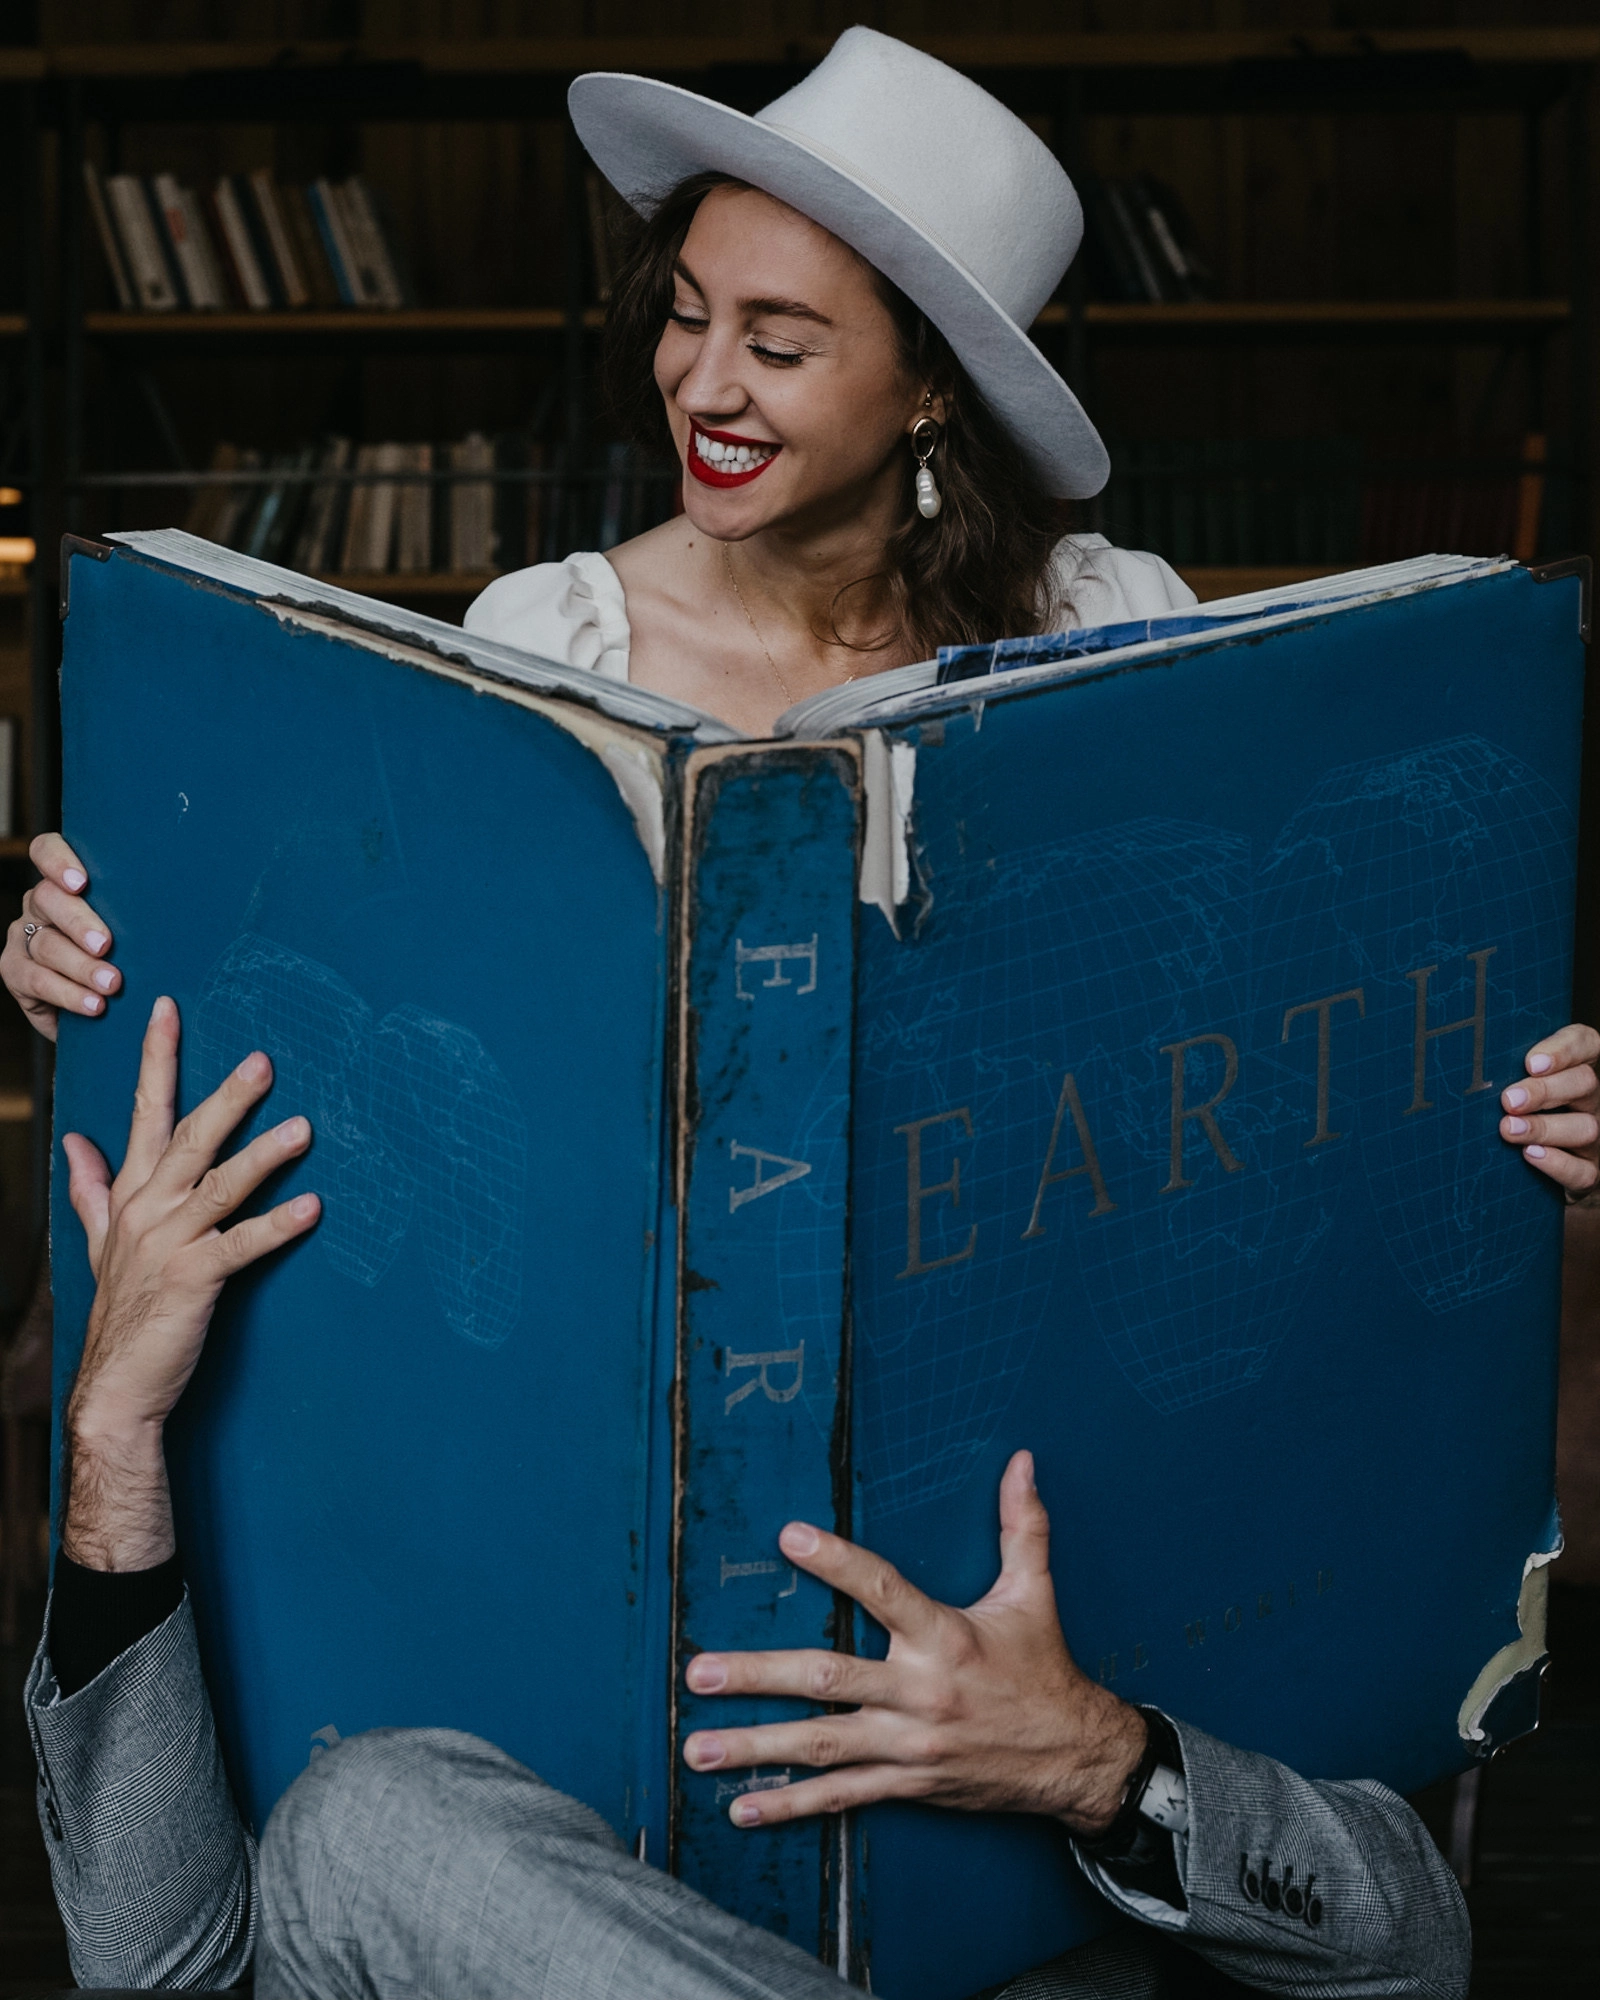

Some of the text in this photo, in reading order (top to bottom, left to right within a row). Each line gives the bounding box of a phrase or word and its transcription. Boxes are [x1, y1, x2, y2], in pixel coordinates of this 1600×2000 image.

[894, 945, 1498, 1281] EARTH
[1098, 1567, 1334, 1682] HE WORLD
